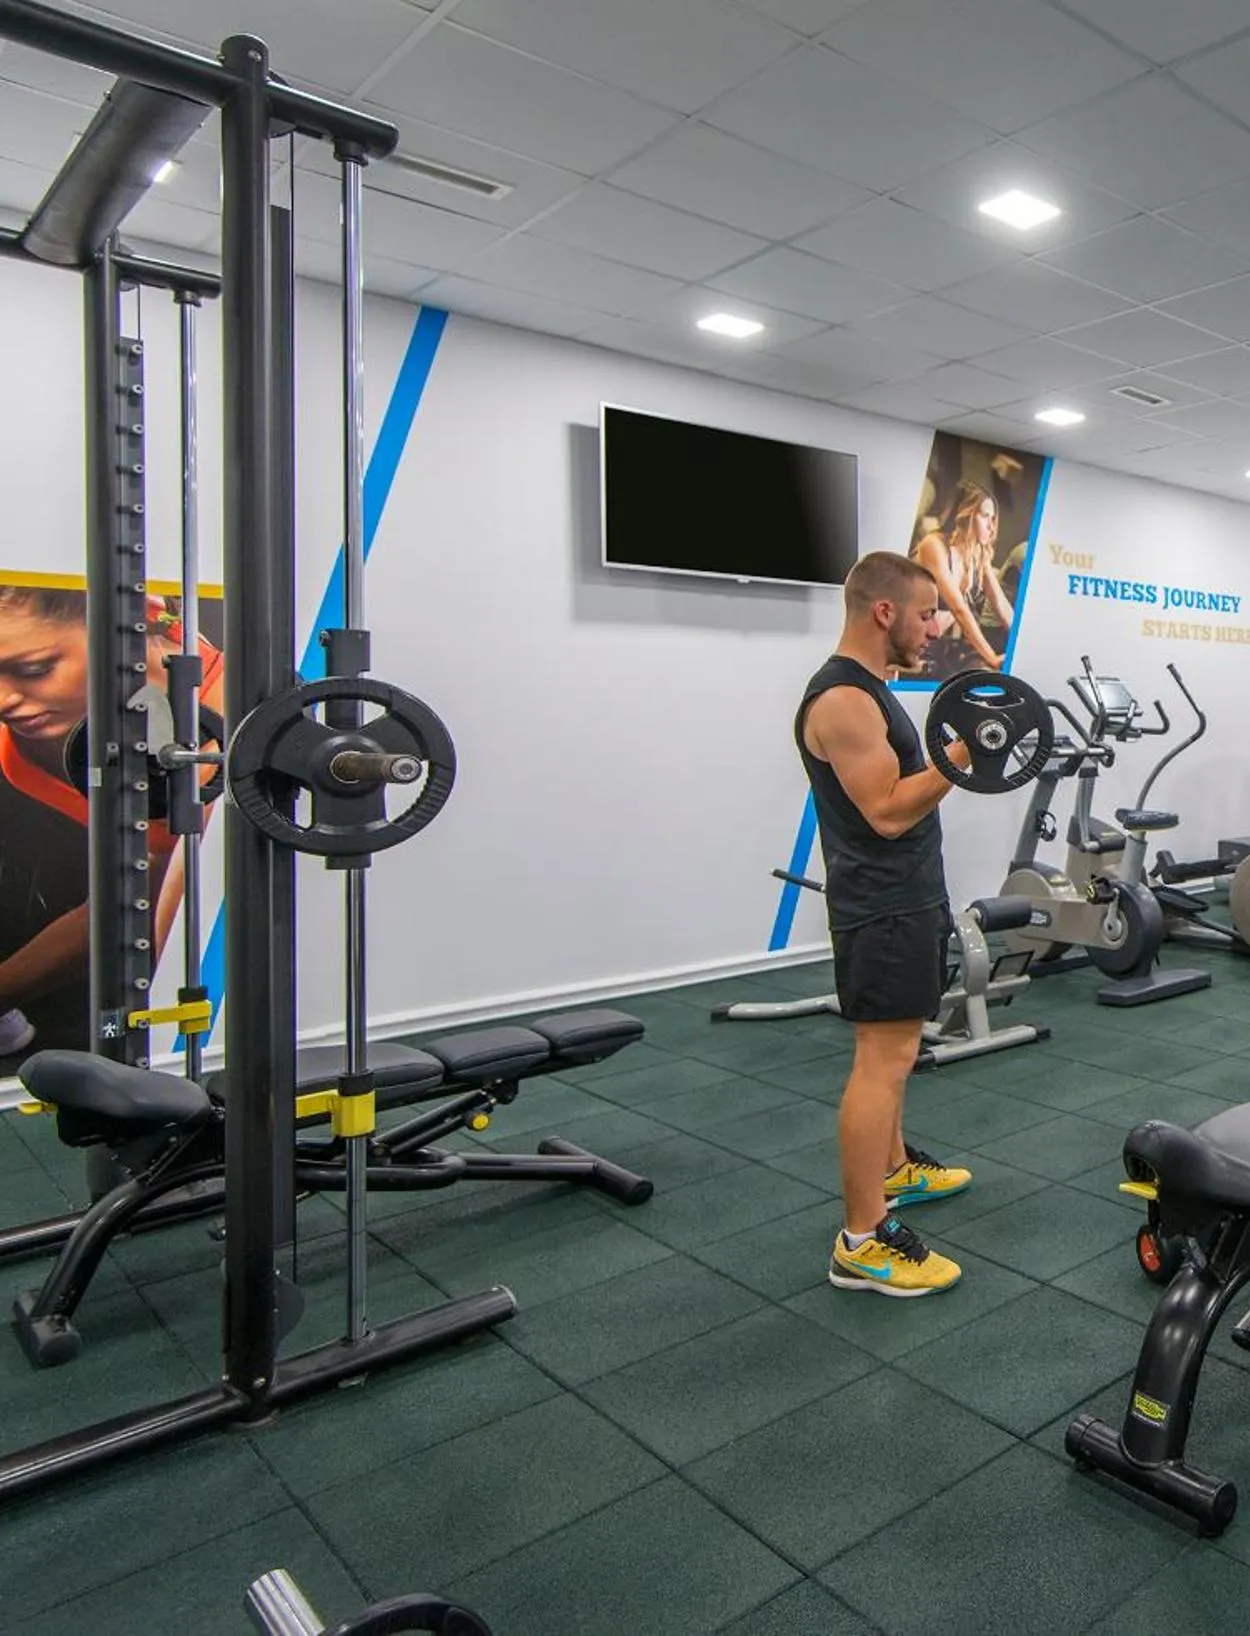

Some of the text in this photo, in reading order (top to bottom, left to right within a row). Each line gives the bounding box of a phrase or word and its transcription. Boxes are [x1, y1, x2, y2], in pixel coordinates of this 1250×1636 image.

[1049, 543, 1094, 570] Your
[1068, 574, 1241, 614] FITNESS JOURNEY
[1141, 619, 1212, 642] STARTS
